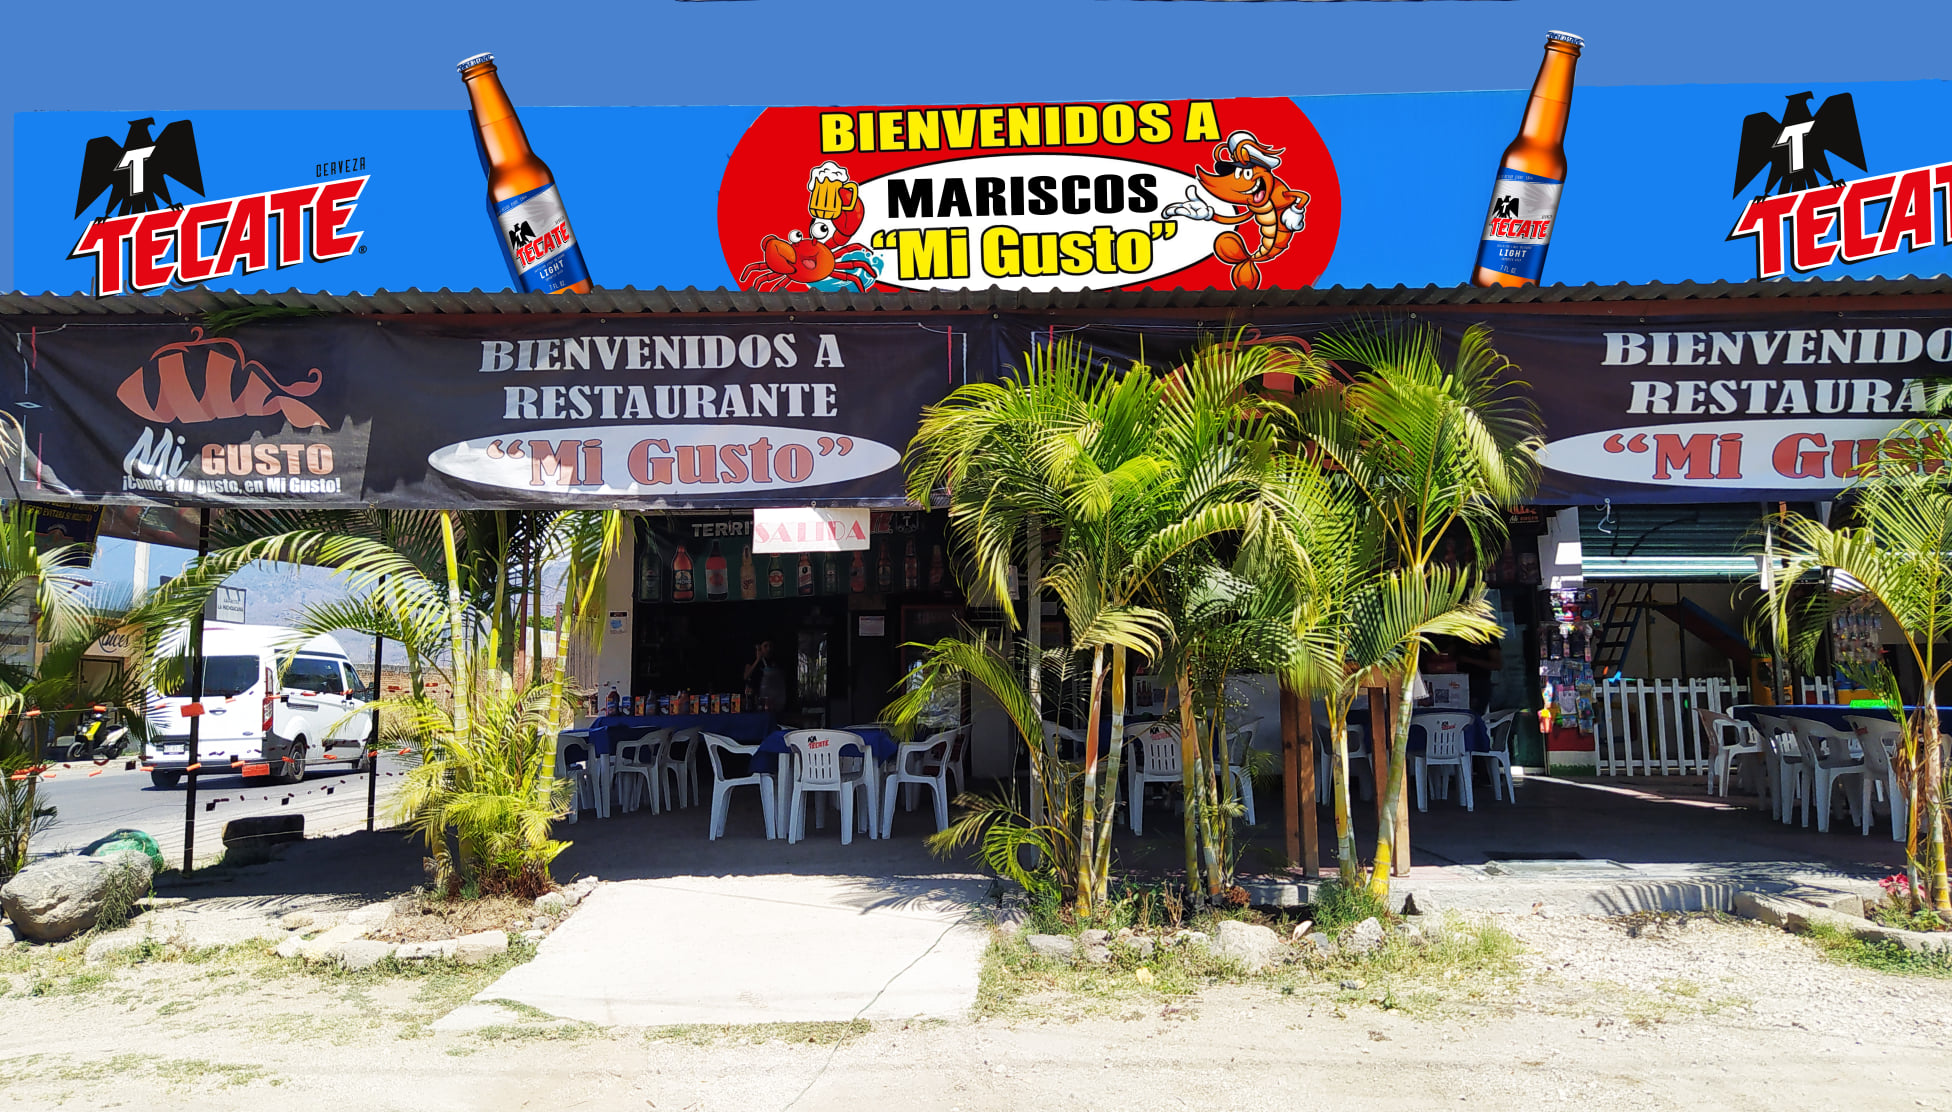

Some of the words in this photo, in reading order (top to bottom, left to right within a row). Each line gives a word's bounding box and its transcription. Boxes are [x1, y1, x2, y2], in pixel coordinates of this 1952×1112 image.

[820, 101, 1172, 154] BIENVENIDOS
[1184, 101, 1222, 142] A
[316, 157, 366, 177] CERVEZA
[887, 173, 1158, 218] MARISCOS
[66, 174, 371, 299] TECATE
[515, 220, 571, 268] TECATE
[1489, 217, 1551, 239] TECATE
[540, 259, 564, 279] LIGHT
[1499, 248, 1527, 258] LIGHT
[479, 333, 798, 372] BIENVENIDOS
[814, 333, 845, 369] A
[503, 382, 838, 420] RESTAURANTE
[123, 425, 190, 480] Mi
[201, 443, 334, 476] GUSTO
[486, 438, 605, 486] “Mi
[627, 436, 855, 486] Gusto”
[1603, 432, 1744, 480] “Mi
[165, 479, 175, 492] a
[178, 477, 194, 493] tu
[197, 478, 243, 495] gusto,
[244, 480, 267, 493] en
[266, 476, 286, 493] Mi
[289, 476, 342, 494] Gusto!
[755, 520, 866, 543] SALIDA
